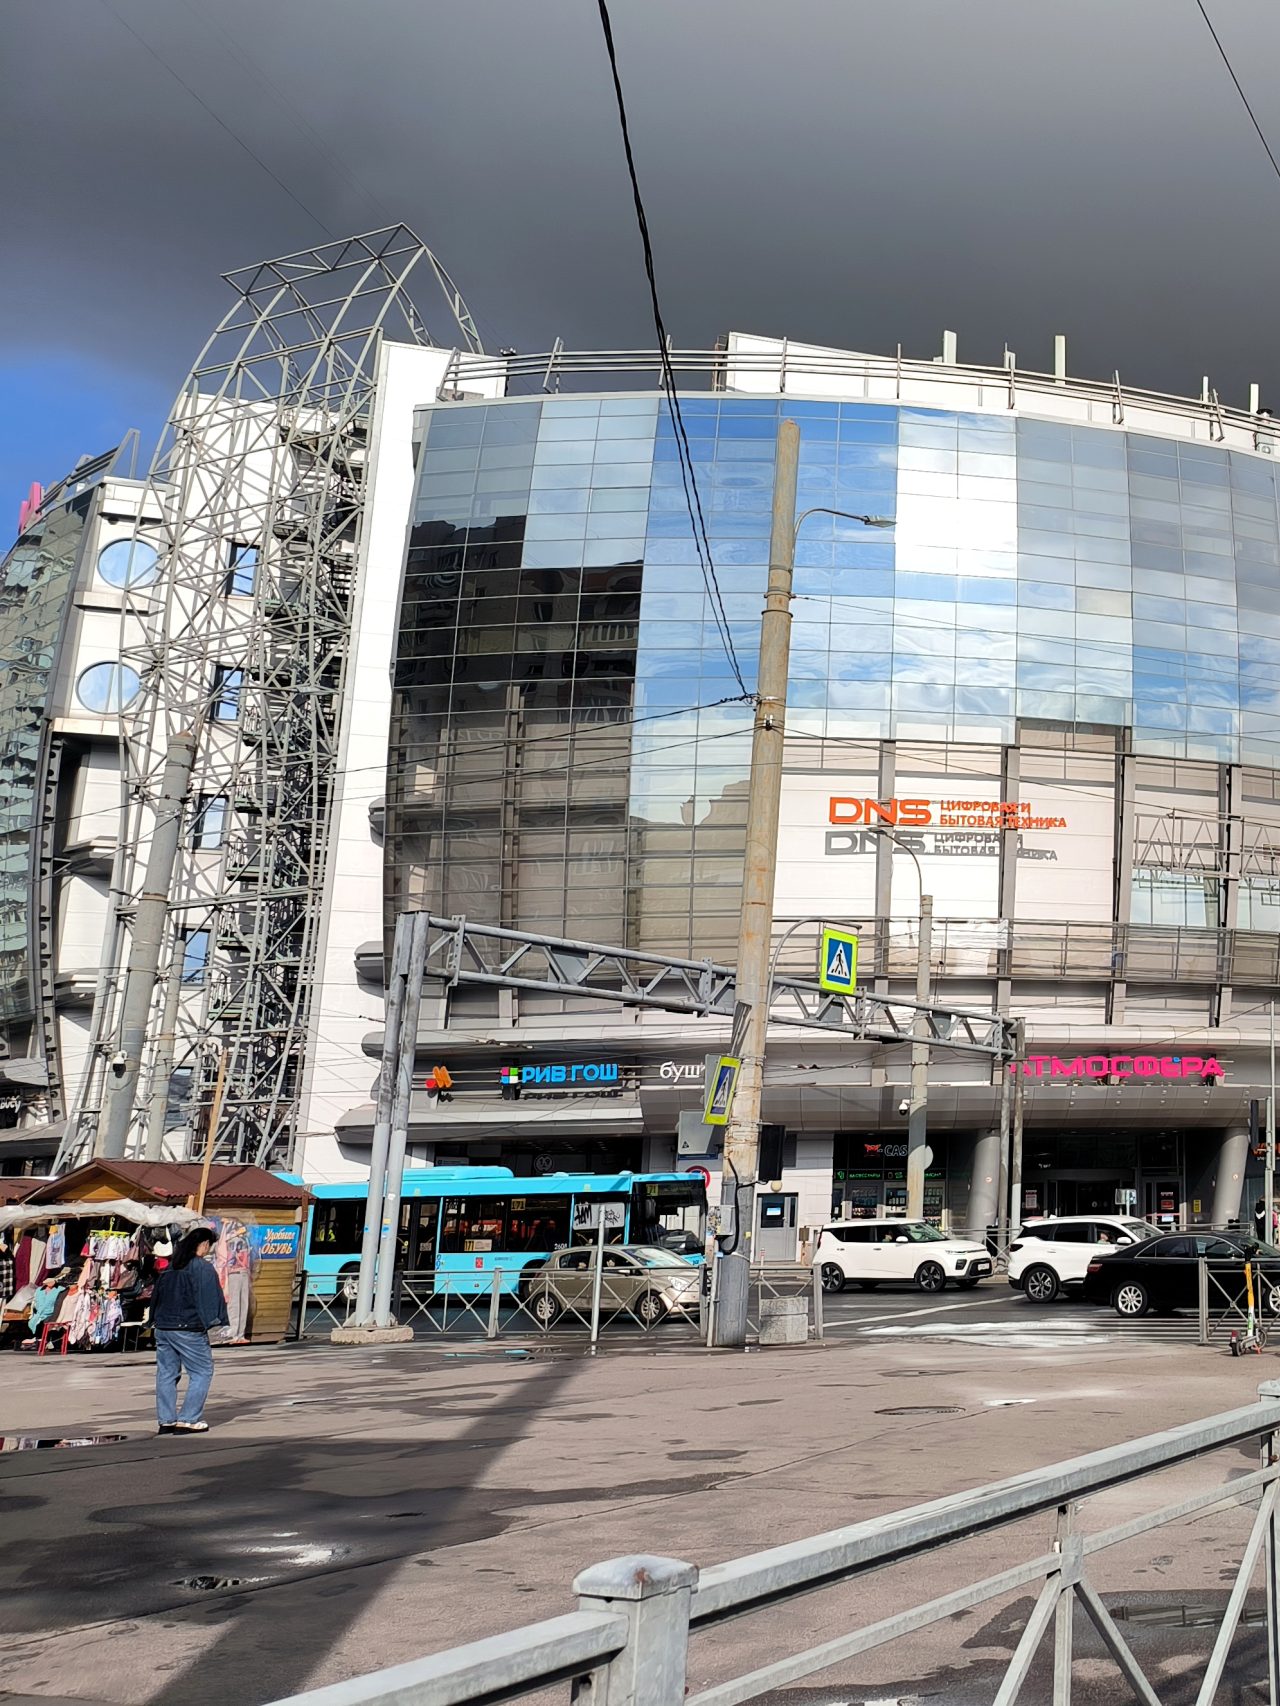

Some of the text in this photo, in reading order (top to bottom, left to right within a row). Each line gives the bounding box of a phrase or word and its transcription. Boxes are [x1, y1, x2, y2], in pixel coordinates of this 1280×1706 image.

[829, 796, 932, 826] DNS
[940, 800, 1031, 813] ЦИФРОВАЯ И
[939, 814, 1067, 829] БЫТОВАЯ ТЕХНИКА
[522, 1063, 618, 1083] РИВ ГОШ
[660, 1061, 706, 1082] буш
[261, 1242, 293, 1254] ОБУВЬ
